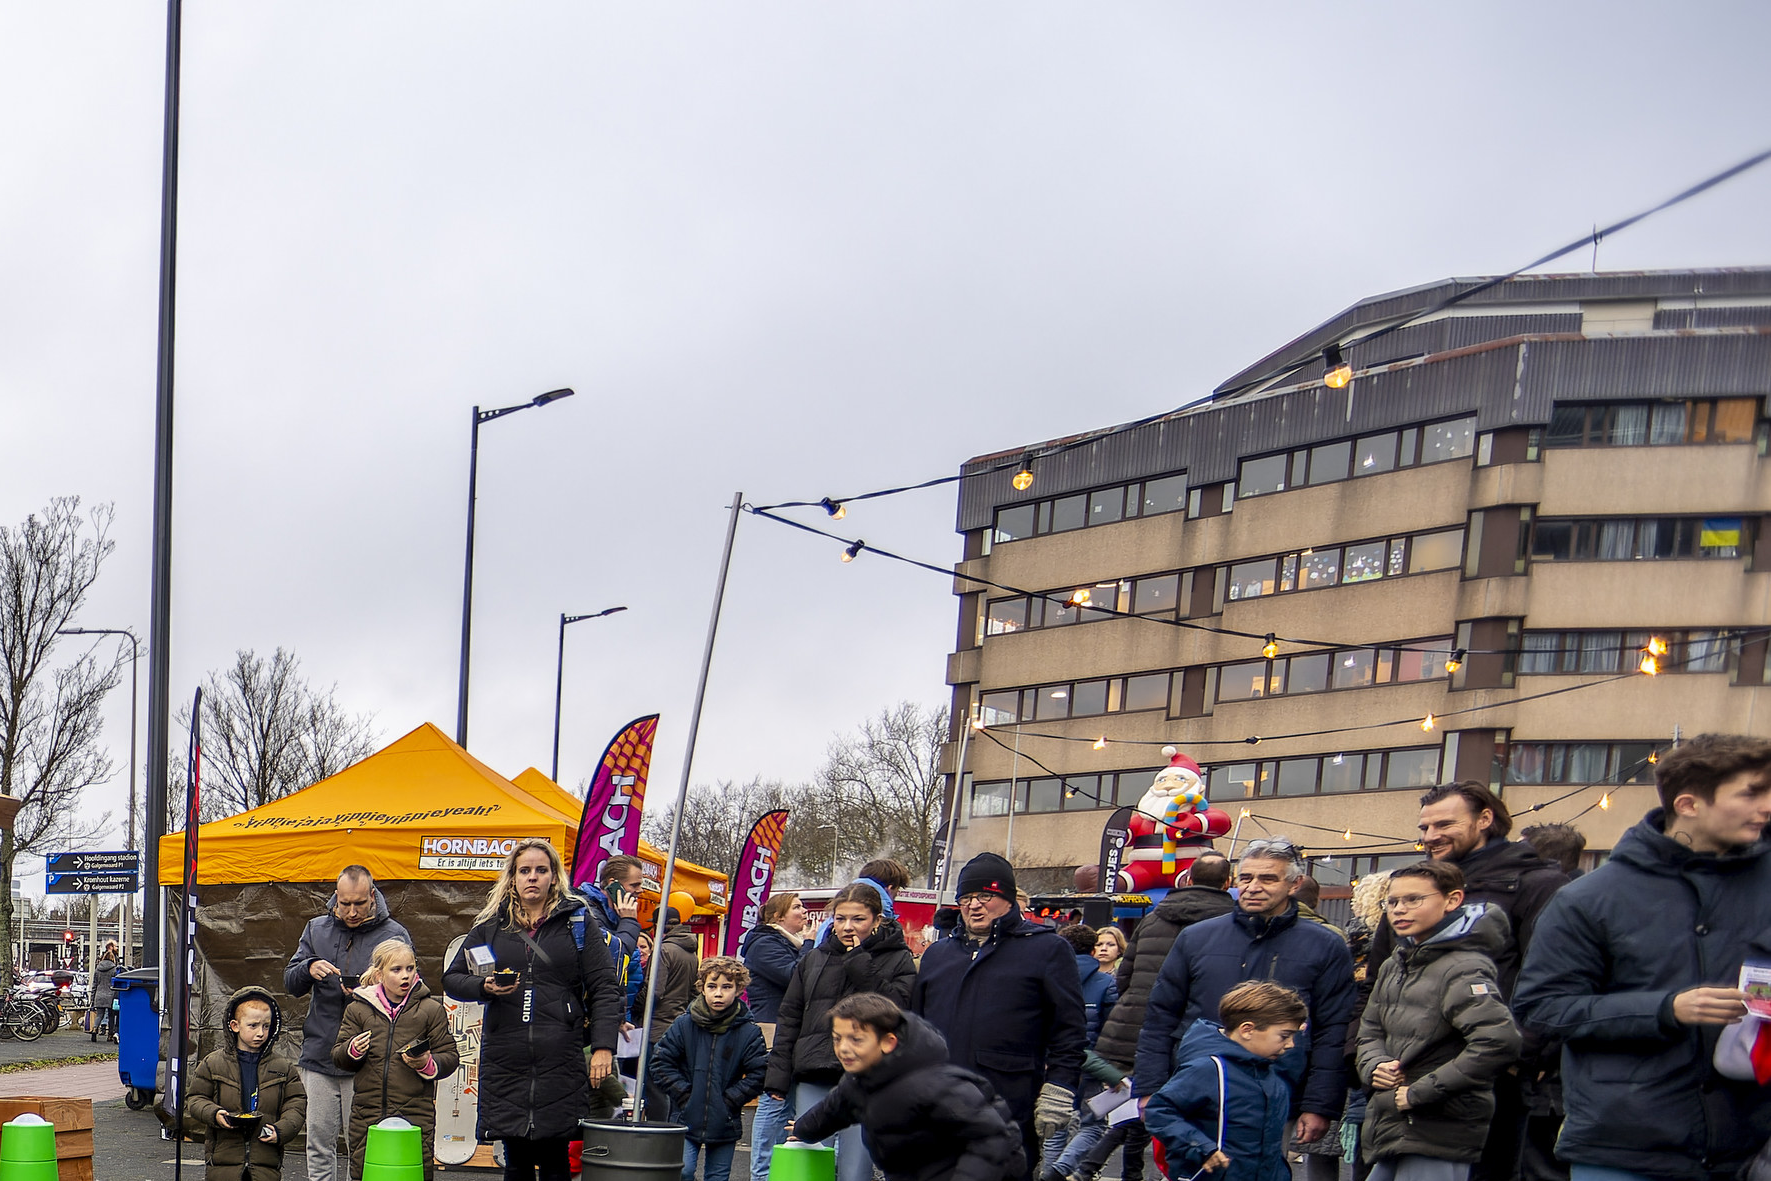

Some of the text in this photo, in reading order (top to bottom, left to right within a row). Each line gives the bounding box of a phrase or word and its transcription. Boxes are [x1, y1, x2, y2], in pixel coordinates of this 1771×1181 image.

[423, 838, 517, 856] HORNBAC
[84, 855, 117, 863] Hoofdingang
[437, 858, 446, 867] Er
[448, 858, 454, 867] is
[457, 858, 477, 869] altijd
[479, 859, 494, 868] iets
